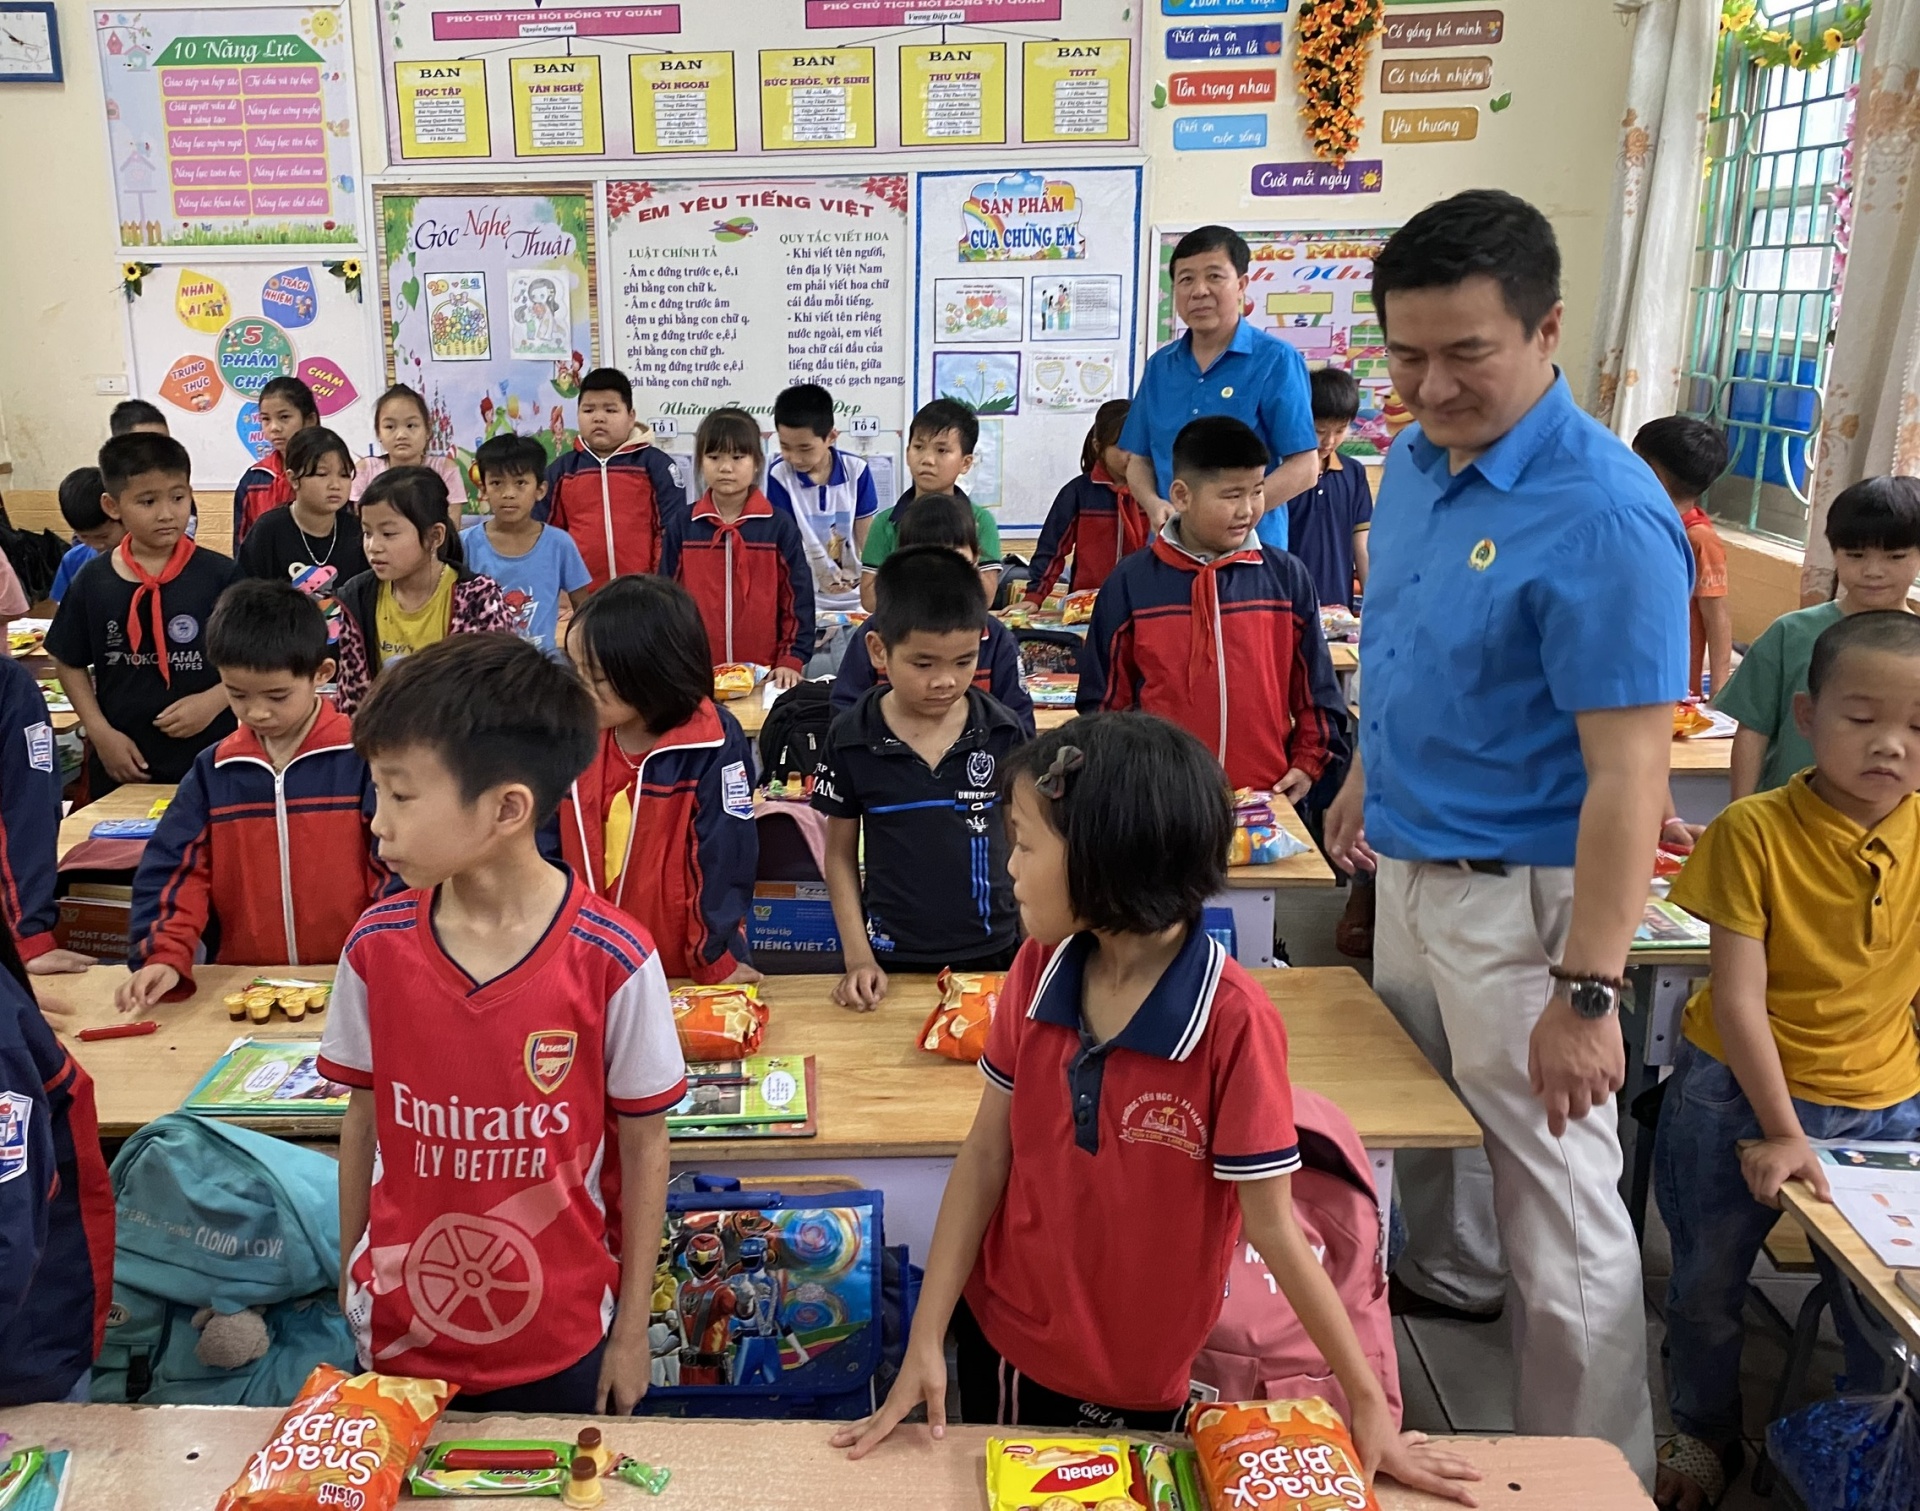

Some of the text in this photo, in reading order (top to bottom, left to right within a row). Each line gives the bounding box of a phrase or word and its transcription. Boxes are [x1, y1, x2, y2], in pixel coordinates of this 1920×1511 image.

[175, 39, 300, 63] 10 Năng Lực
[929, 51, 972, 61] BAN
[1058, 47, 1101, 57] BAN
[534, 63, 576, 74] BAN
[660, 60, 703, 70] BAN
[793, 56, 835, 66] BAN
[420, 68, 461, 78] BAN
[1069, 69, 1097, 77] TDTT
[1174, 77, 1270, 100] Tôn trọng nhau
[1390, 117, 1459, 139] Yêu thương
[638, 191, 874, 222] EM YÊU TIẾNG VIỆT
[415, 205, 572, 259] Góc Nghệ Thuật
[780, 229, 889, 244] QUY TẮC VIẾT HOA
[1004, 223, 1052, 247] CHÚNG
[1056, 227, 1075, 246] EM
[629, 245, 717, 259] LUẬT CHÍNH TẢ
[793, 248, 811, 258] Khi
[814, 246, 832, 258] viết
[836, 248, 851, 257] tên
[630, 264, 646, 277] Âm
[658, 267, 681, 279] đứng
[684, 267, 710, 276] trước
[787, 263, 882, 277] tên địa lý Việt Nam
[182, 283, 213, 297] NHÂN
[624, 280, 716, 295] ghi bằng con chữ k.
[805, 279, 826, 292] phải
[829, 278, 847, 290] viết
[851, 280, 868, 289] hoa
[871, 279, 889, 289] chữ
[787, 294, 873, 308] cái đầu mỗi tiếng.
[795, 311, 881, 323] Khi viết tên riêng
[242, 326, 263, 345] 5
[788, 328, 811, 338] nước
[814, 327, 843, 340] ngoài,
[865, 325, 882, 337] viết
[788, 341, 883, 354] hoa chữ cái đầu của
[222, 349, 278, 367] PHẨM
[789, 357, 881, 372] tiếng đầu tiên, giữa
[172, 362, 205, 379] TRUNG
[647, 375, 669, 389] bằng
[672, 379, 688, 387] con
[691, 376, 709, 386] chữ
[712, 376, 731, 388] ngh.
[835, 375, 845, 385] có
[849, 374, 871, 386] gạch
[669, 422, 674, 432] 1
[852, 417, 876, 432] Tổ 4
[827, 938, 836, 952] 3
[538, 1042, 570, 1053] Arsenal
[392, 1081, 570, 1141] Emirates
[453, 1147, 547, 1183] BETTER
[195, 1226, 238, 1256] CLOUD
[249, 1444, 380, 1489] Snack
[1057, 1462, 1114, 1481] nabati
[1224, 1473, 1366, 1509] Snack
